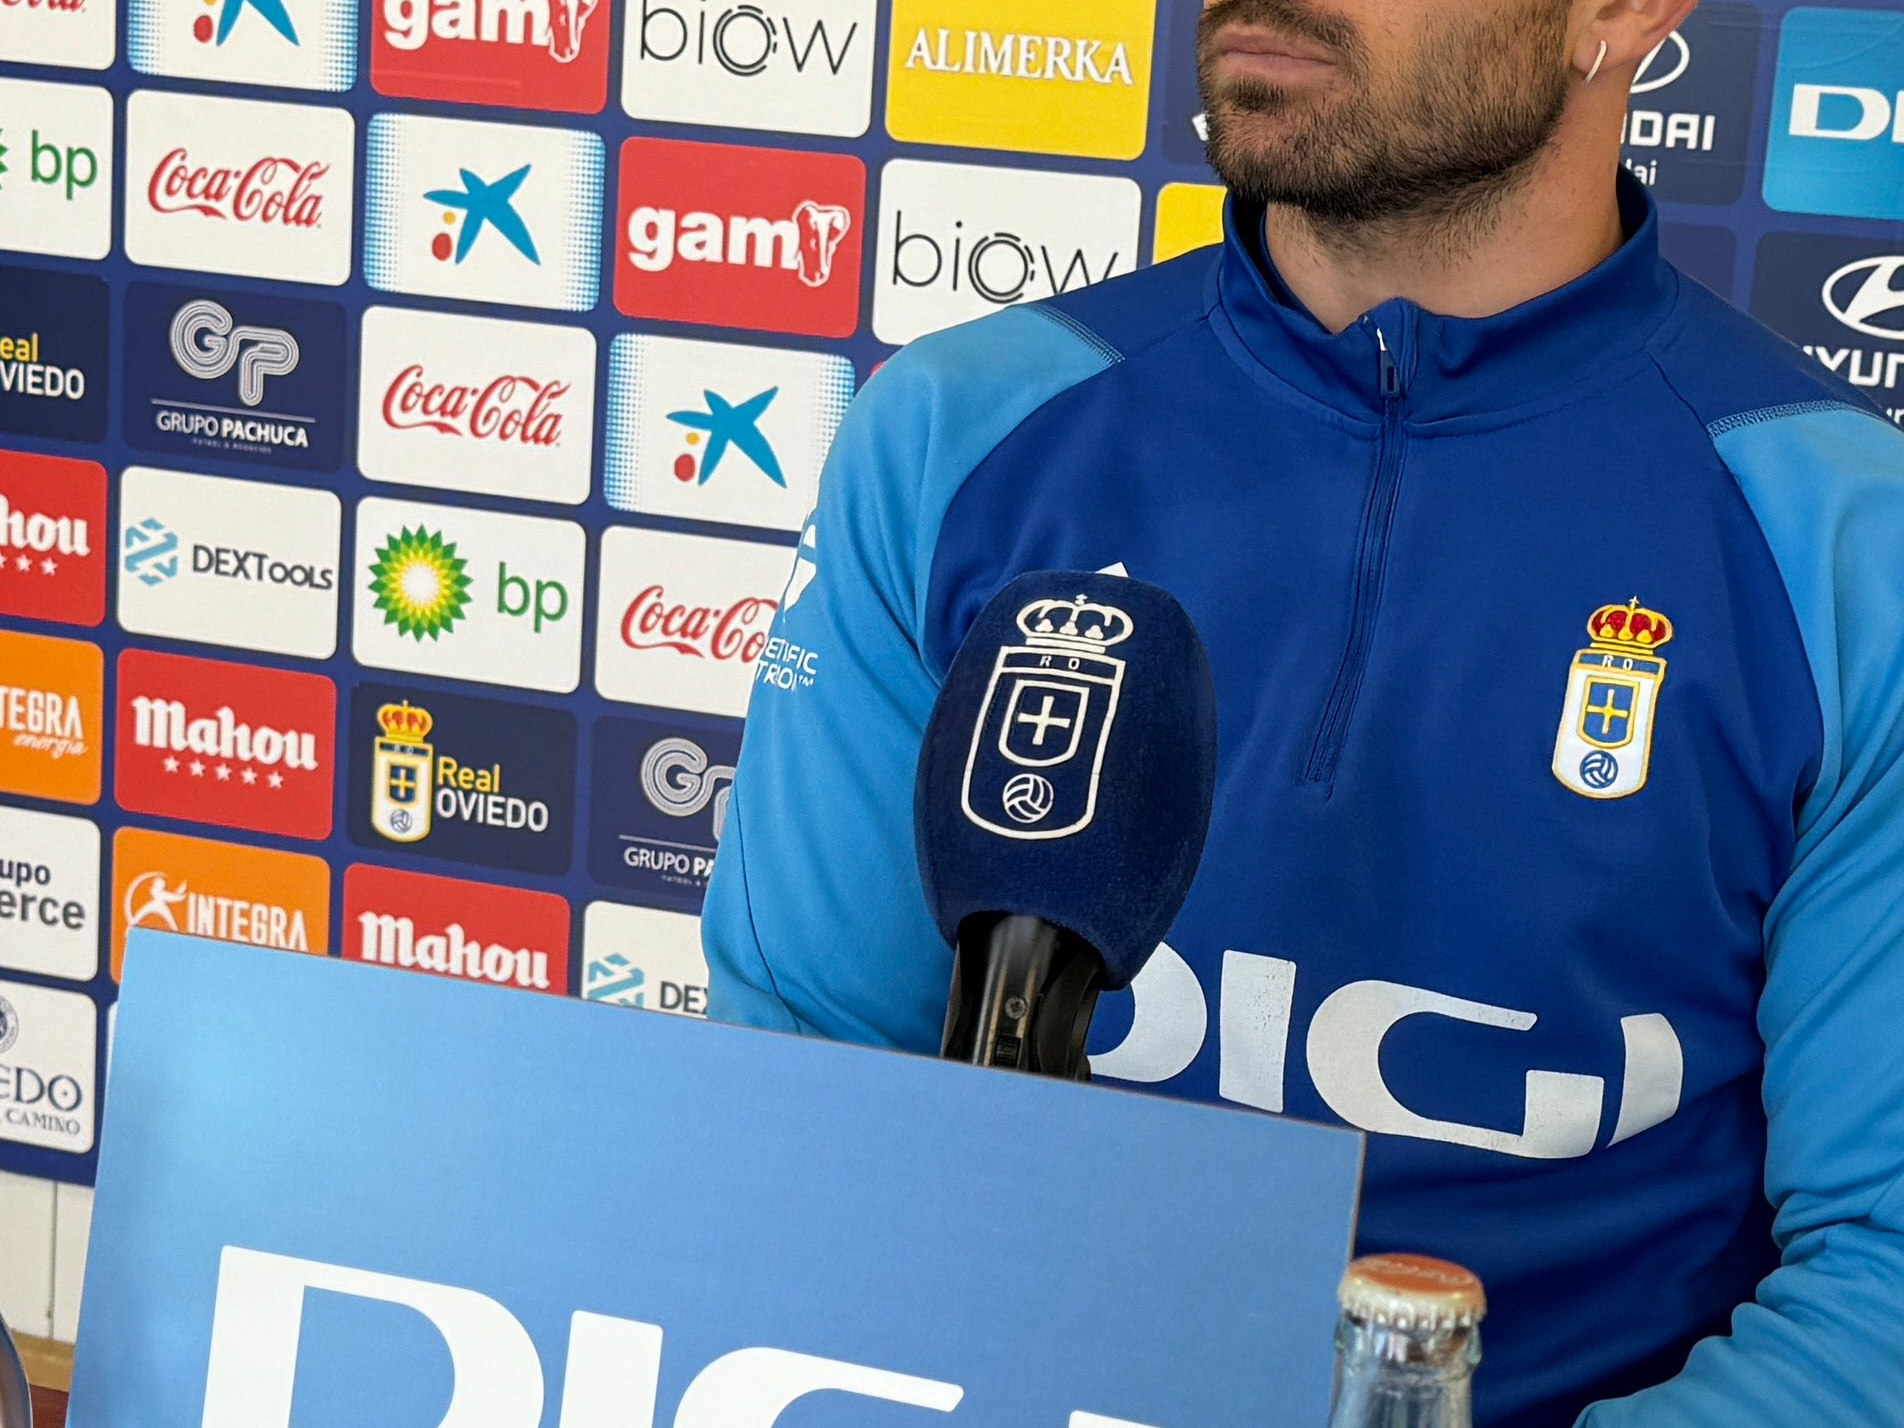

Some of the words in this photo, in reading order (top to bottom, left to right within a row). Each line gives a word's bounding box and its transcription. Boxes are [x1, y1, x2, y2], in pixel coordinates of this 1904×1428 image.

[905, 28, 1134, 84] ALIMERKA
[31, 130, 97, 200] bp
[628, 203, 797, 271] gam
[155, 411, 216, 435] GRUPO
[221, 420, 308, 448] PACHUCA
[381, 365, 564, 447] Coca-Cola
[497, 572, 568, 630] bp
[132, 695, 317, 770] Mahou
[437, 756, 500, 793] Real
[436, 791, 549, 832] OVIEDO
